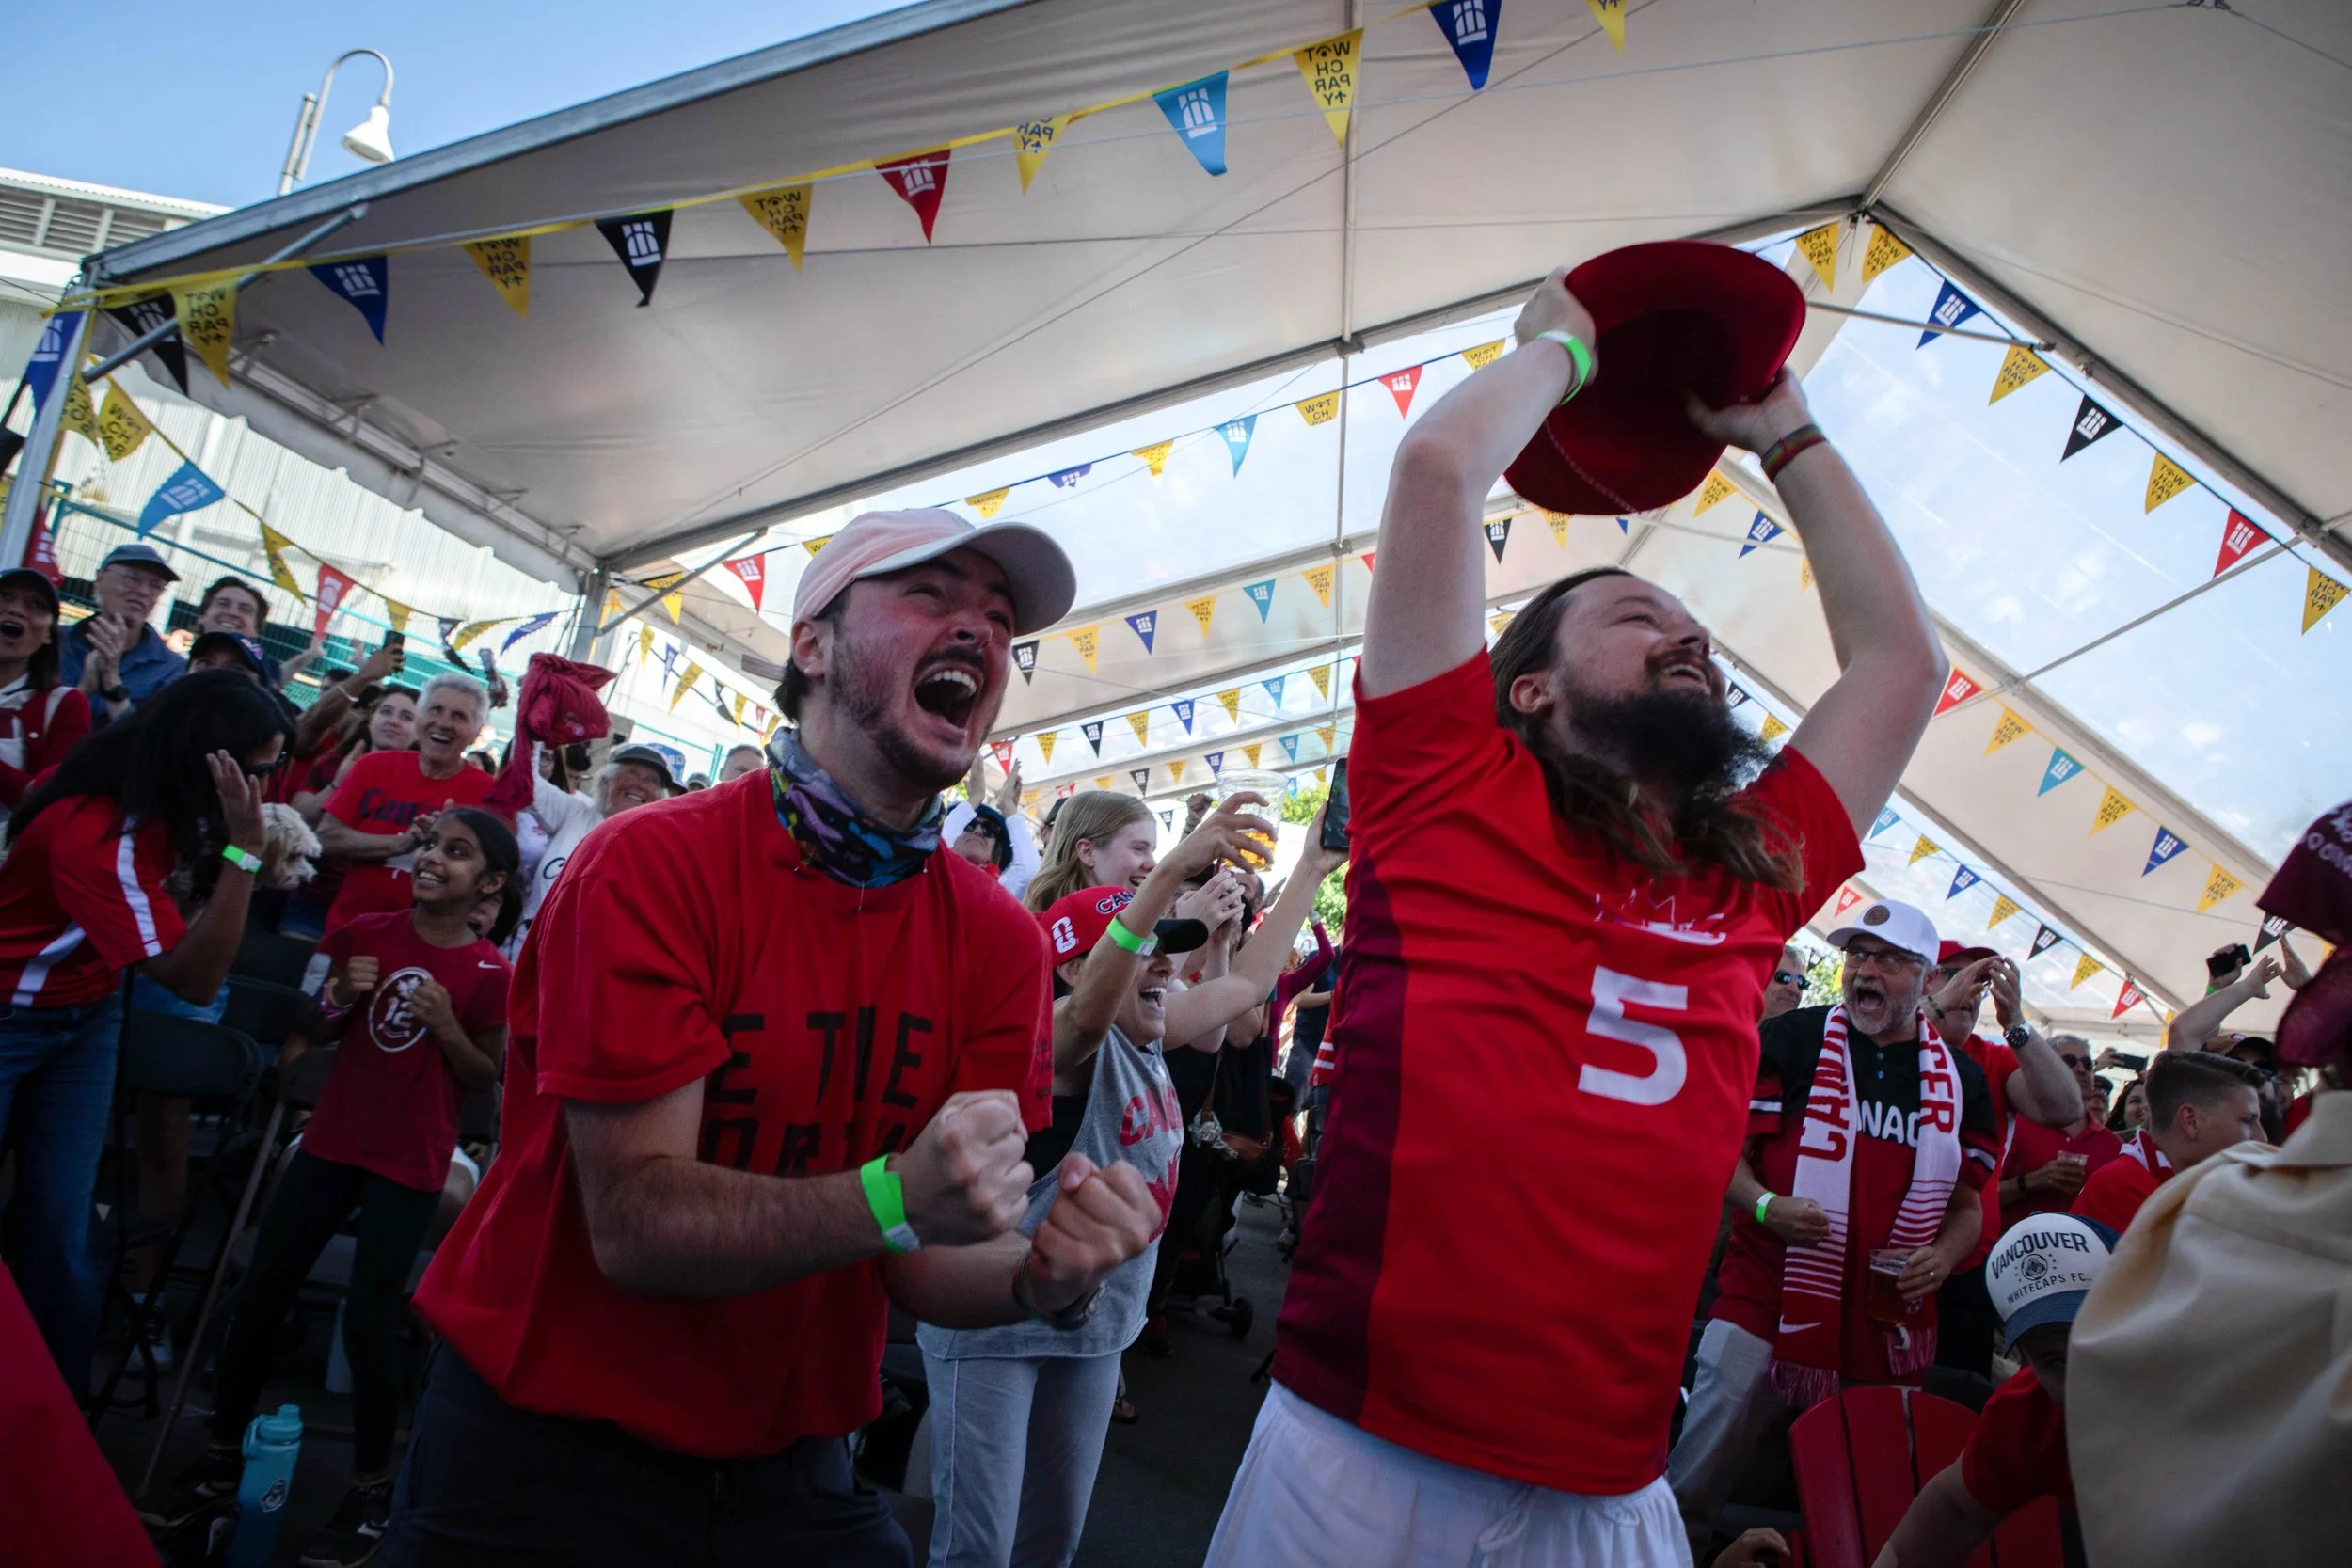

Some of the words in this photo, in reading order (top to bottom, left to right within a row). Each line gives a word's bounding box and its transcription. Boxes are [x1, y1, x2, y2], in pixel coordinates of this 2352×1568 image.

[1312, 409, 1329, 420] CH
[1578, 962, 1688, 1106] 5
[1991, 1231, 2090, 1280] VANCOUVER
[2006, 1274, 2066, 1305] WHITECAPS
[2071, 1272, 2087, 1283] FC
